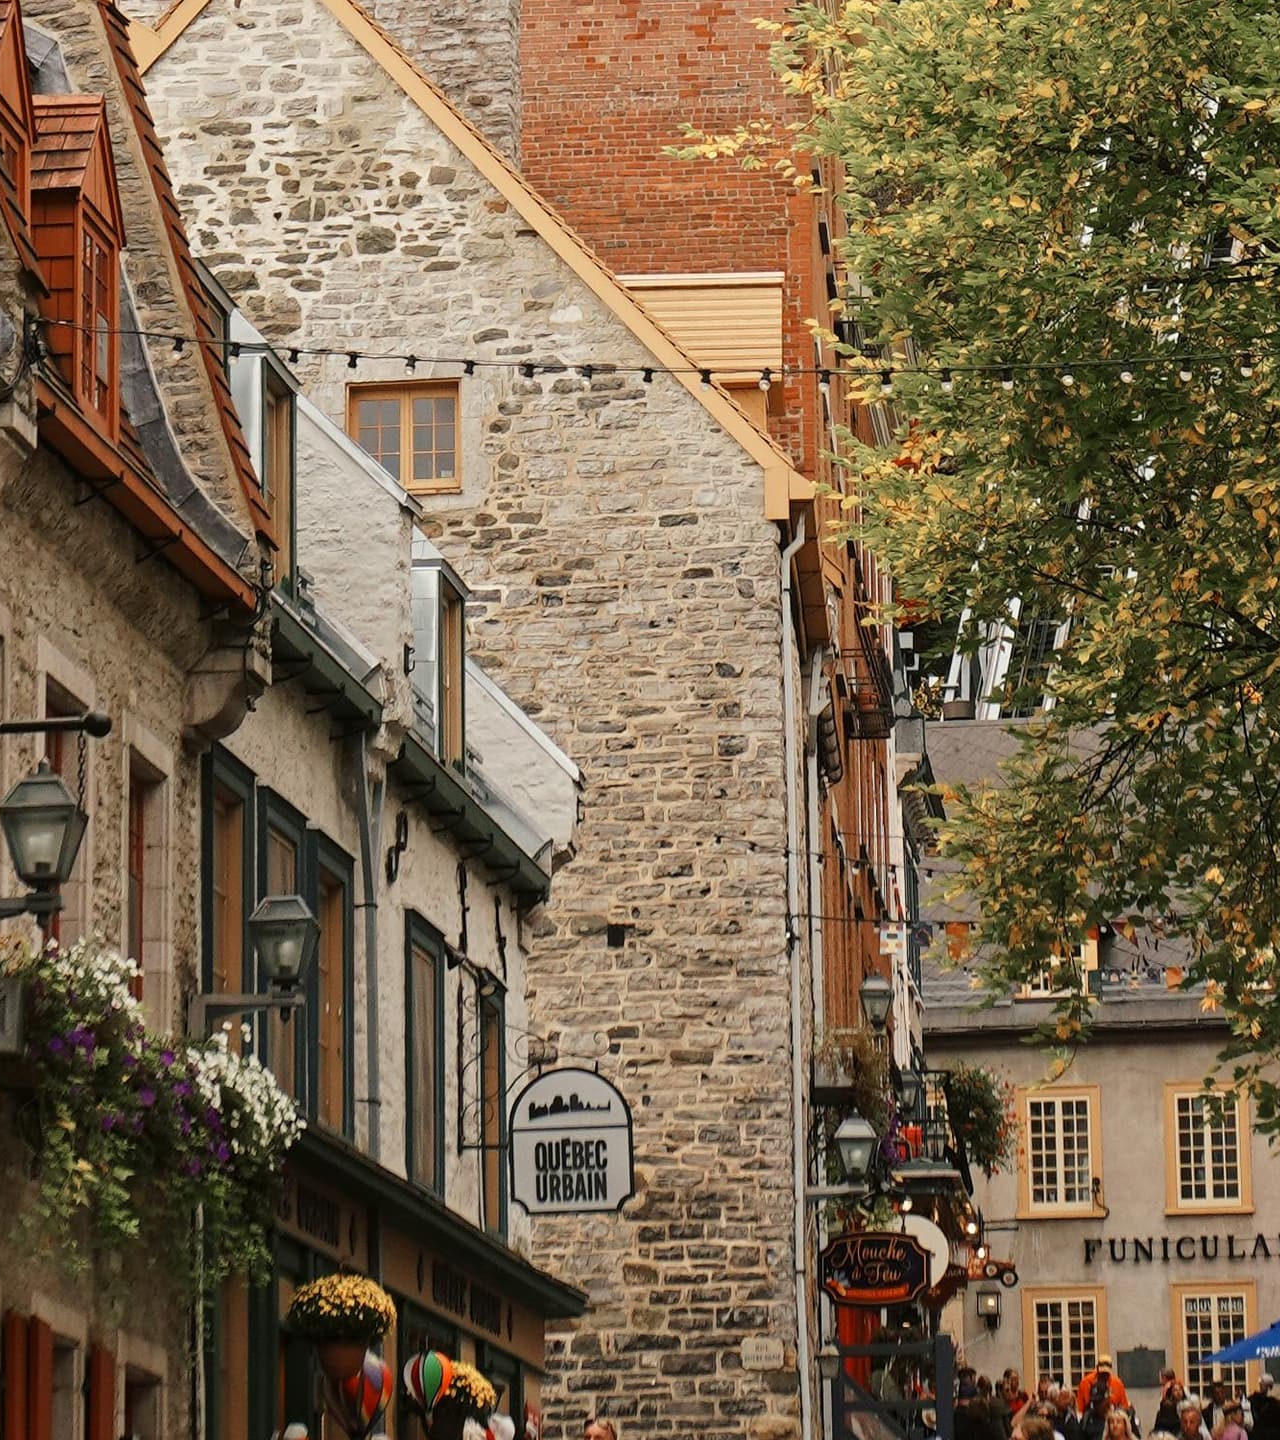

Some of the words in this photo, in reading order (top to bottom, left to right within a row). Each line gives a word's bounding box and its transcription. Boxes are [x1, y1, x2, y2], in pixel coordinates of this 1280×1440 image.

[534, 1137, 608, 1175] QUÉBEC
[535, 1171, 608, 1203] URBAIN
[830, 1237, 907, 1268] Mouche
